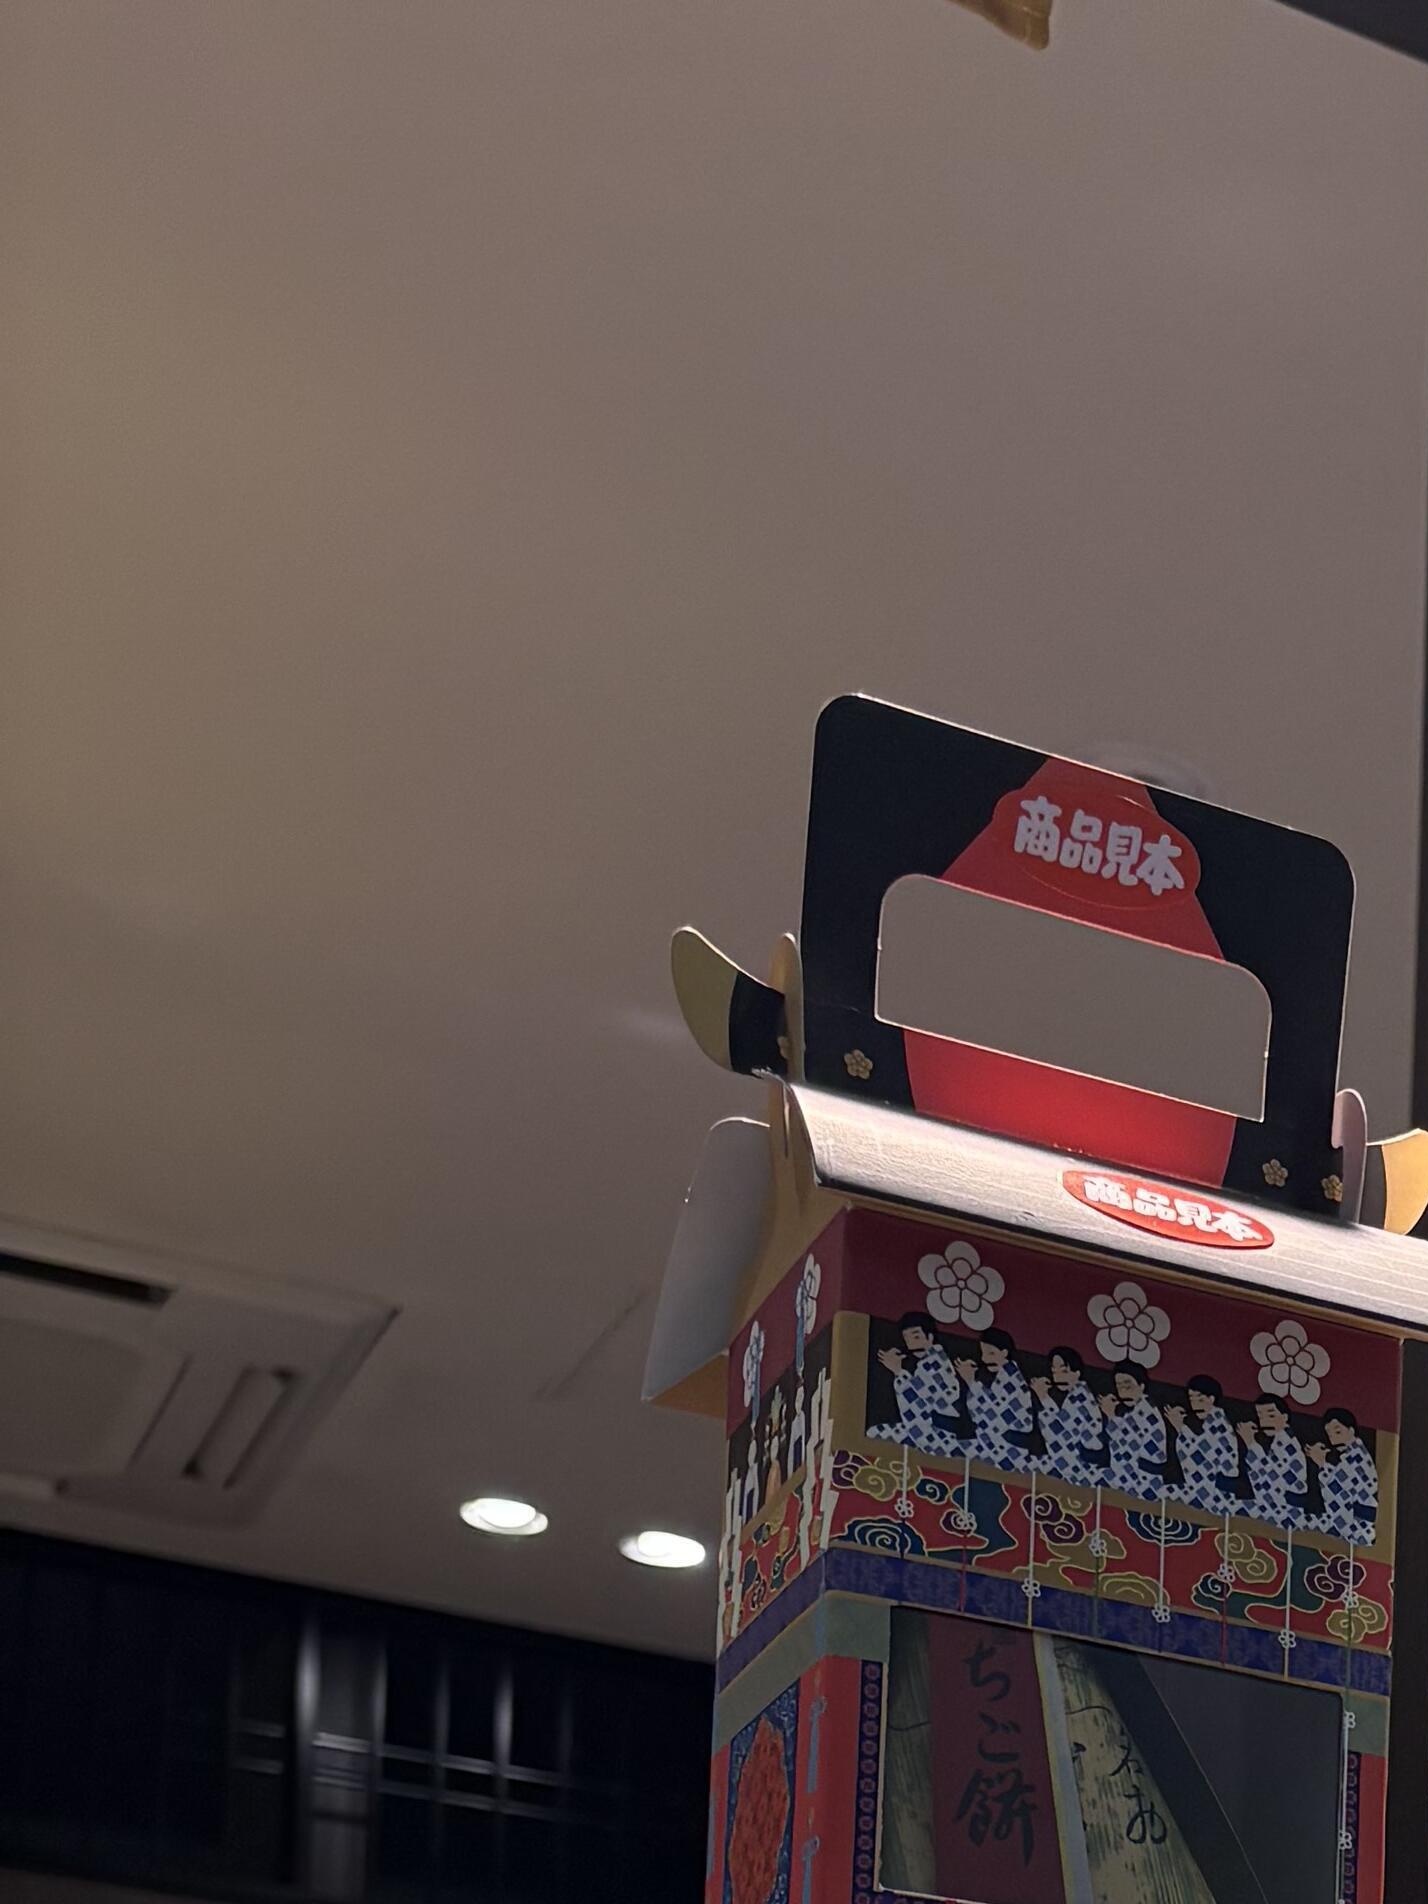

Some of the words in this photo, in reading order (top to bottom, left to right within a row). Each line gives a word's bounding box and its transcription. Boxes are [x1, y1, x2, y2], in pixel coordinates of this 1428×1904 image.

[1013, 795, 1185, 895] 商品見本
[1083, 1174, 1264, 1243] 商品見本
